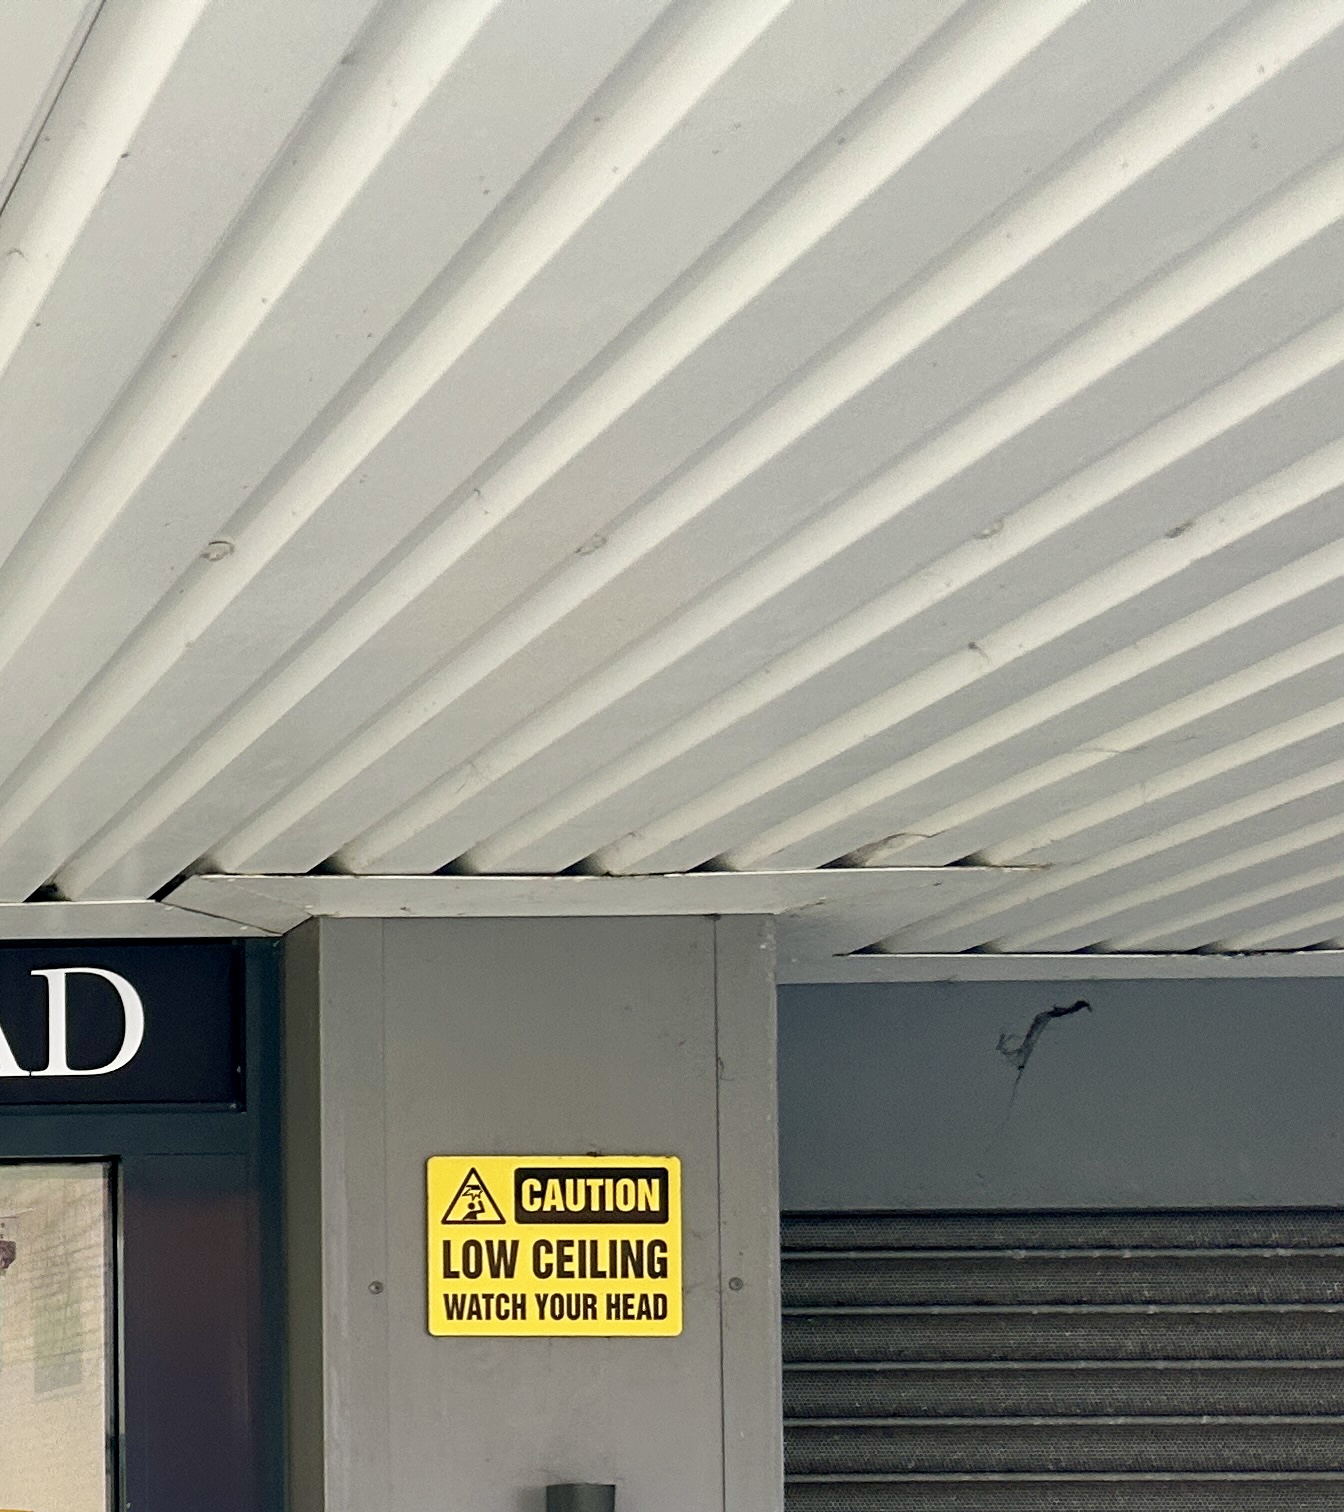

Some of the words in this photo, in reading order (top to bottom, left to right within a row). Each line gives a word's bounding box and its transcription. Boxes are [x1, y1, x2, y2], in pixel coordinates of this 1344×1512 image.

[521, 1178, 660, 1212] CAUTION
[442, 1239, 519, 1279] LOW
[532, 1239, 668, 1279] CEILING
[443, 1293, 527, 1321] WATCH
[534, 1293, 597, 1321] YOUR
[606, 1293, 668, 1321] HEAD
